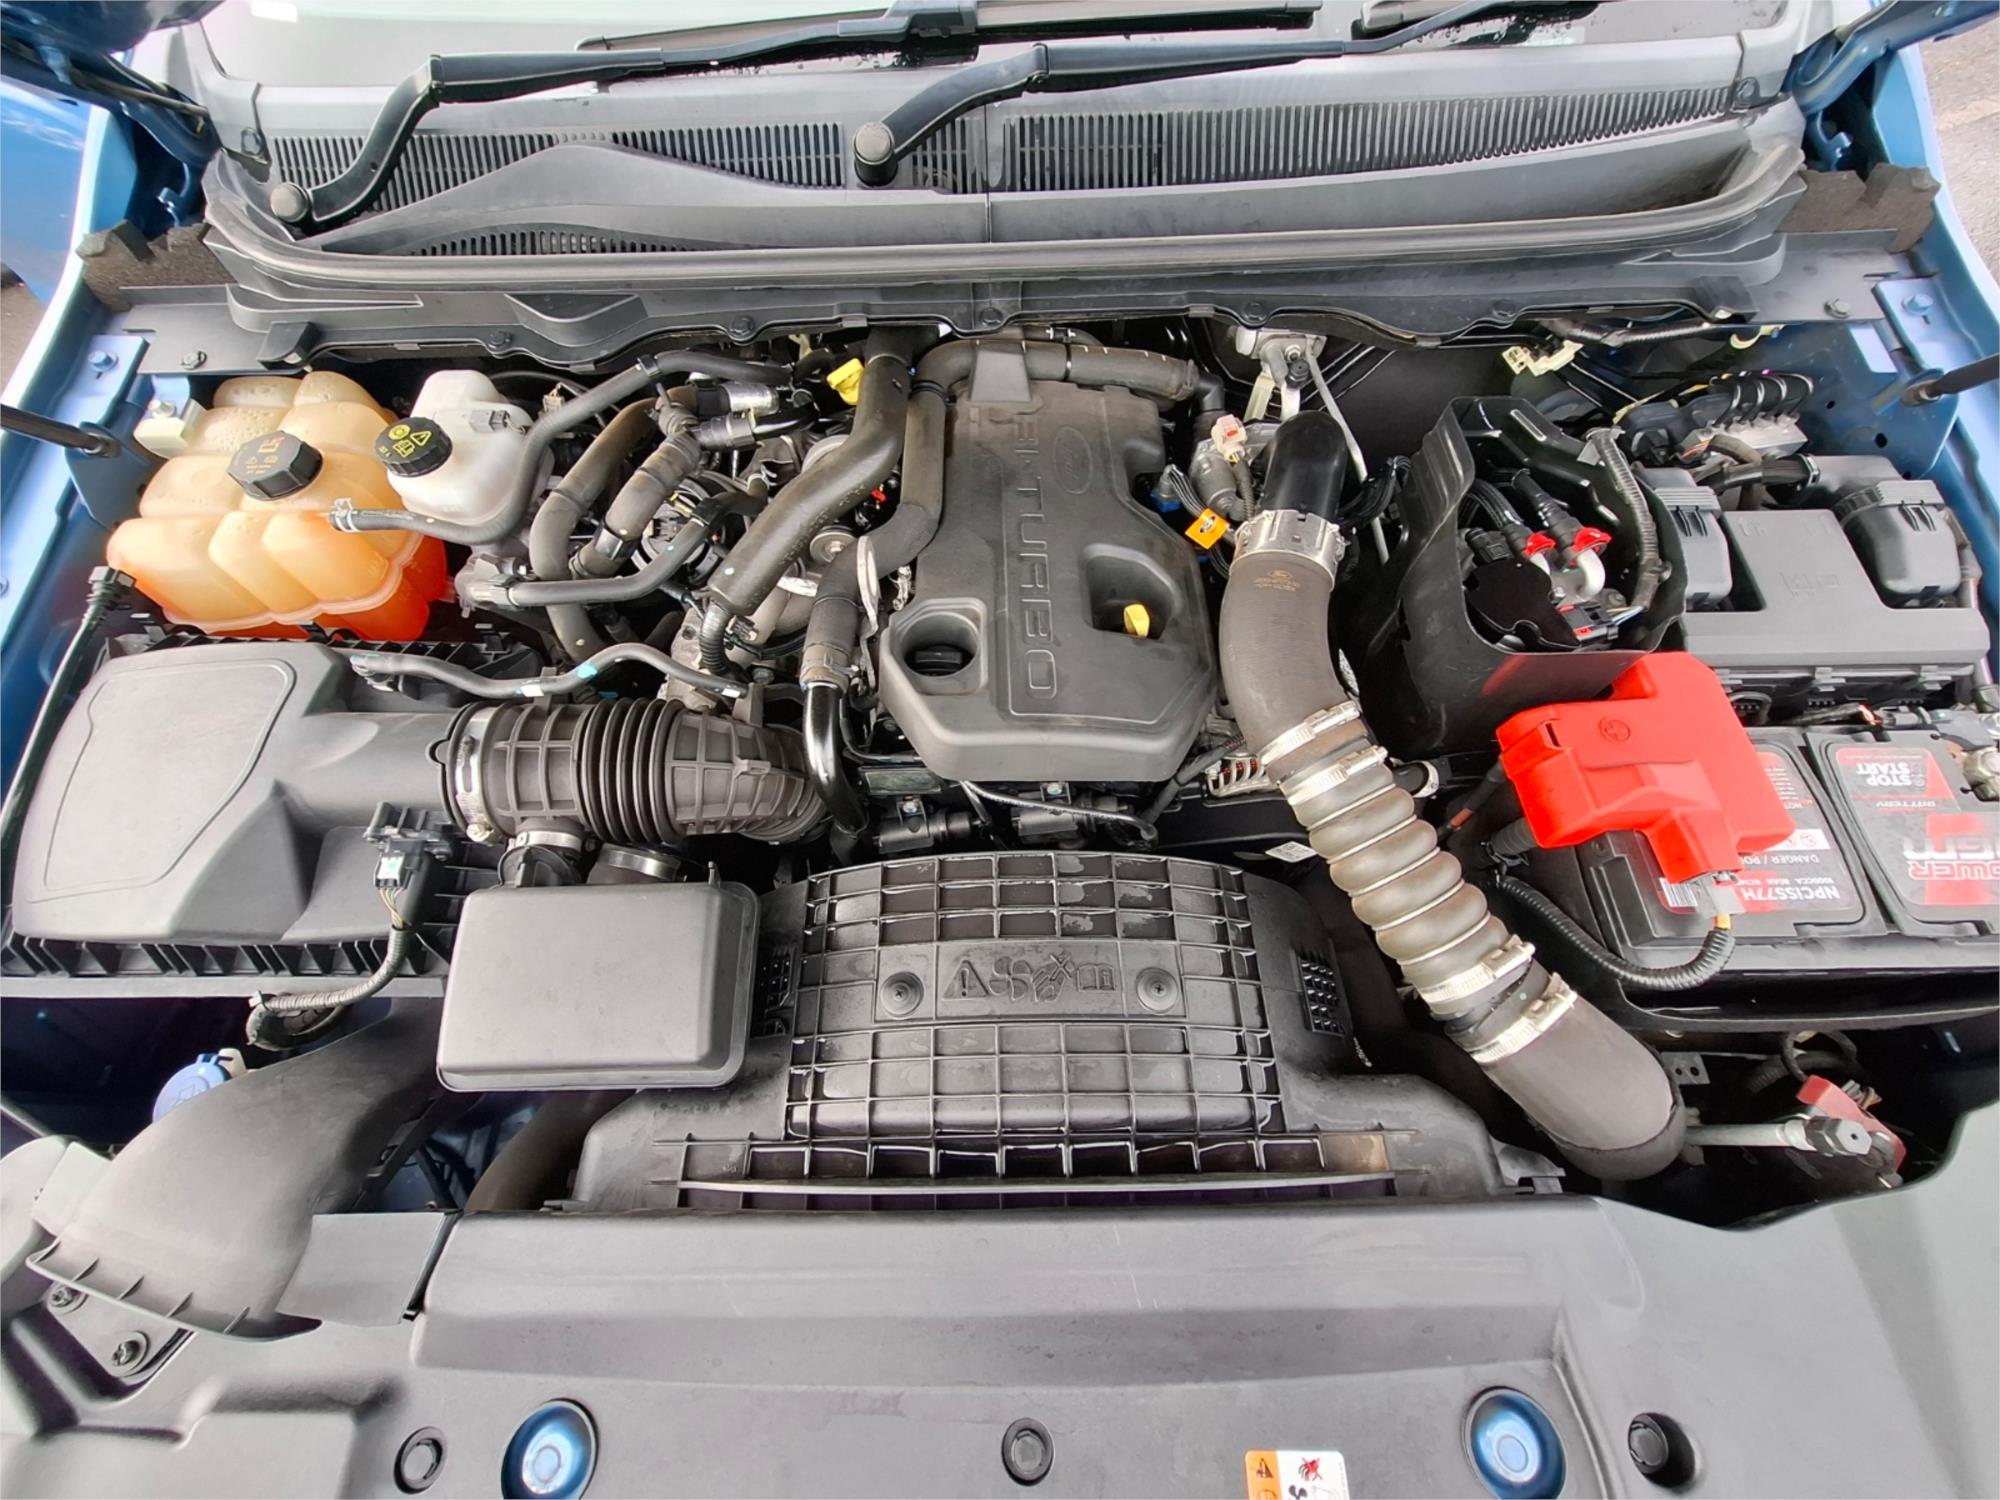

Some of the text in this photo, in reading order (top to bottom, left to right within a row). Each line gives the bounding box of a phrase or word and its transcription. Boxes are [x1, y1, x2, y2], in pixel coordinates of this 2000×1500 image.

[1856, 763, 1910, 775] START
[1866, 774, 1912, 786] STOP
[1771, 854, 1820, 865] DANGER
